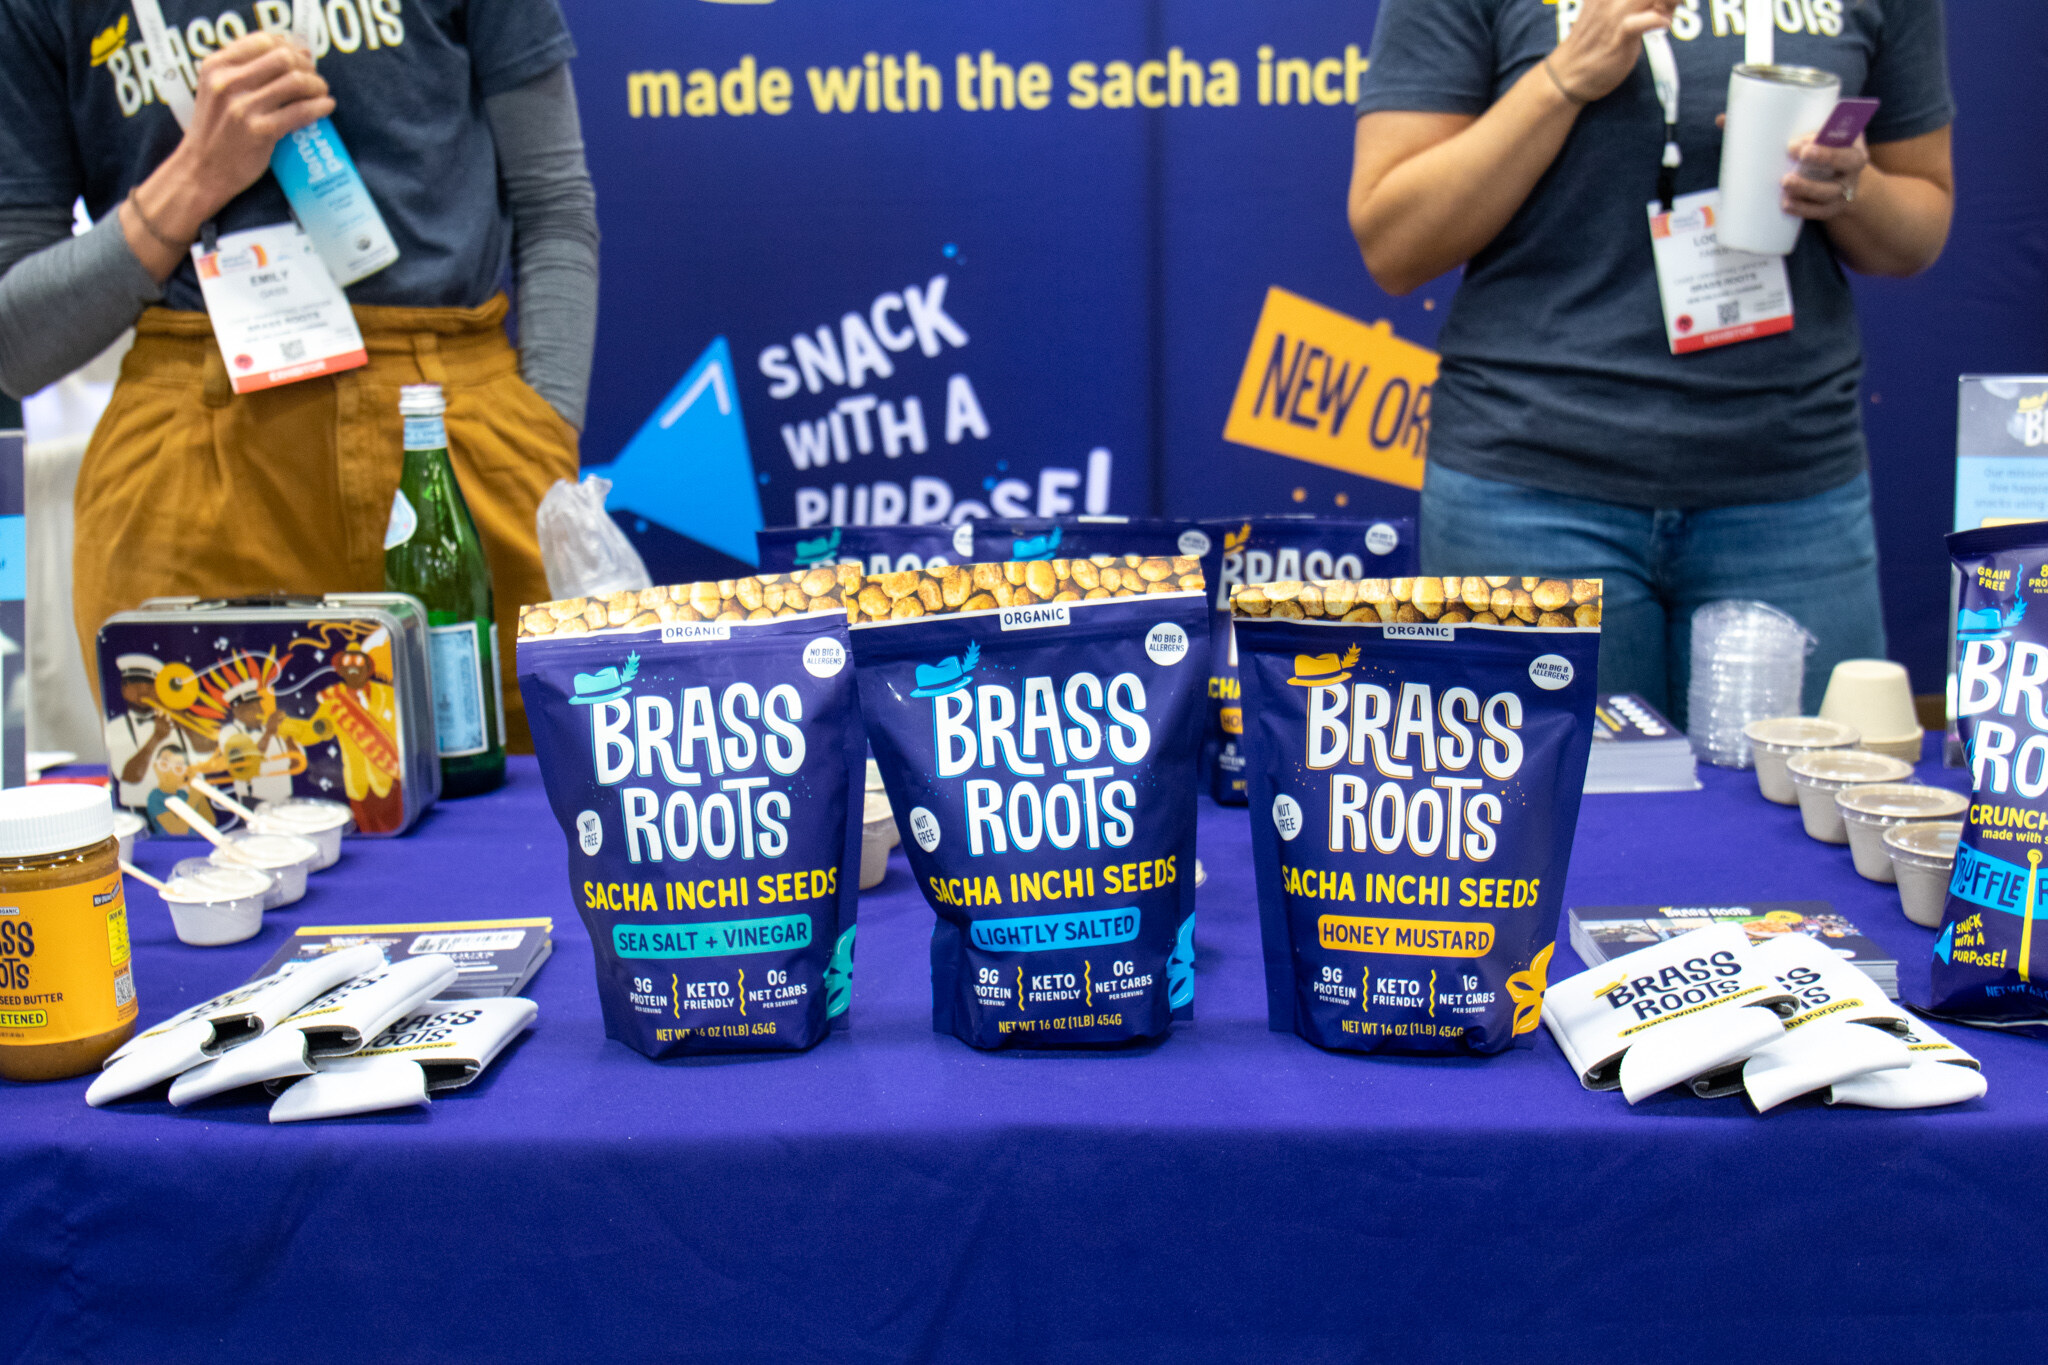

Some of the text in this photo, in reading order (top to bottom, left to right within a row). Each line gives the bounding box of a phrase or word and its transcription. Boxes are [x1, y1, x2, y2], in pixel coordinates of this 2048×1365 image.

[1710, 0, 1844, 37] ROTS
[628, 45, 1368, 117] made with the sacha inch
[292, 130, 326, 184] lemo
[250, 270, 288, 286] EMILY
[758, 274, 969, 398] SNACK
[1253, 333, 1370, 437] NEW
[781, 374, 990, 469] WITH A
[1977, 566, 2011, 580] GRAIN
[1979, 577, 2006, 592] FREE
[1003, 608, 1065, 626] ORGANIC
[665, 625, 725, 639] ORGANIC
[1152, 634, 1183, 644] NO BIG 8
[1386, 626, 1449, 638] ORGANIC
[810, 648, 840, 657] NO BIG 8
[1149, 643, 1185, 652] ALLERGENS
[806, 656, 843, 666] ALLERGENS
[1536, 661, 1569, 674] NO BIG 8
[1532, 668, 1570, 682] ALLERGENS
[1208, 677, 1241, 699] CHA
[1958, 638, 2048, 731] BR
[932, 671, 1151, 778] BRASS
[1306, 682, 1523, 780] BRASS
[591, 682, 807, 786] BRASS
[964, 767, 1137, 857] ROOTS
[1276, 803, 1290, 817] NUT
[1329, 774, 1502, 862] ROOTS
[1970, 804, 2048, 831] CRUNCH
[583, 818, 596, 833] NUT
[621, 777, 791, 863] ROOTS
[914, 815, 928, 830] NUT
[1278, 817, 1297, 832] FREE
[584, 832, 598, 848] FREE
[918, 829, 937, 845] FREE
[1982, 829, 2042, 844] made with
[929, 855, 1177, 907] SACHA INCHI SEEDS
[1952, 846, 2025, 908] TRUFFLE
[584, 866, 838, 912] SACHA INCHI SEEDS
[1282, 865, 1540, 909] SACHA INCHI SEEDS
[975, 915, 1135, 946] LIGHTLY SALTED
[1956, 913, 1983, 934] SNACK
[619, 922, 808, 952] SEA SALT + VINEGAR
[1323, 922, 1490, 950] HONEY MUSTARD
[1955, 932, 1985, 947] WITH A
[1953, 949, 2008, 969] PURPOSE!
[978, 967, 999, 985] 9G
[1113, 960, 1134, 977] 0G
[1321, 966, 1343, 984] 9G
[633, 976, 653, 994] 9G
[766, 970, 787, 986] 0G
[1031, 974, 1076, 991] KETO
[1095, 974, 1153, 993] NET CARBS
[1376, 978, 1420, 995] KETO
[1462, 974, 1478, 991] 1G
[1604, 950, 1742, 1010] BRASS
[0, 992, 64, 1006] SEED BUTTER
[629, 992, 668, 1007] PROTEIN
[686, 982, 730, 999] KETO
[749, 984, 807, 1002] NET CARBS
[1029, 989, 1081, 1003] FRIENDLY
[1120, 990, 1143, 999] SERVING
[1313, 982, 1357, 999] PROTEIN
[1439, 992, 1495, 1005] NET CARBS
[683, 997, 735, 1011] FRIENDLY
[775, 999, 798, 1008] SERVING
[1331, 997, 1350, 1006] SERVING
[1372, 995, 1424, 1008] FRIENDLY
[1632, 979, 1740, 1021] ROOTS
[1465, 1006, 1486, 1014] SERVING
[1623, 987, 1763, 1037] #SnackWithAPurpose
[387, 1009, 483, 1034] RASS
[998, 1013, 1122, 1033] NET WT 16 OZ (1LB) 454G
[1342, 1020, 1464, 1038] NET WT 16 OZ (1LB) 454G
[364, 1029, 453, 1049] OOTS
[656, 1028, 673, 1042] NET
[675, 1028, 691, 1041] WT
[707, 1025, 721, 1037] OZ
[722, 1023, 749, 1038] (1LB)
[751, 1022, 777, 1036] 454G
